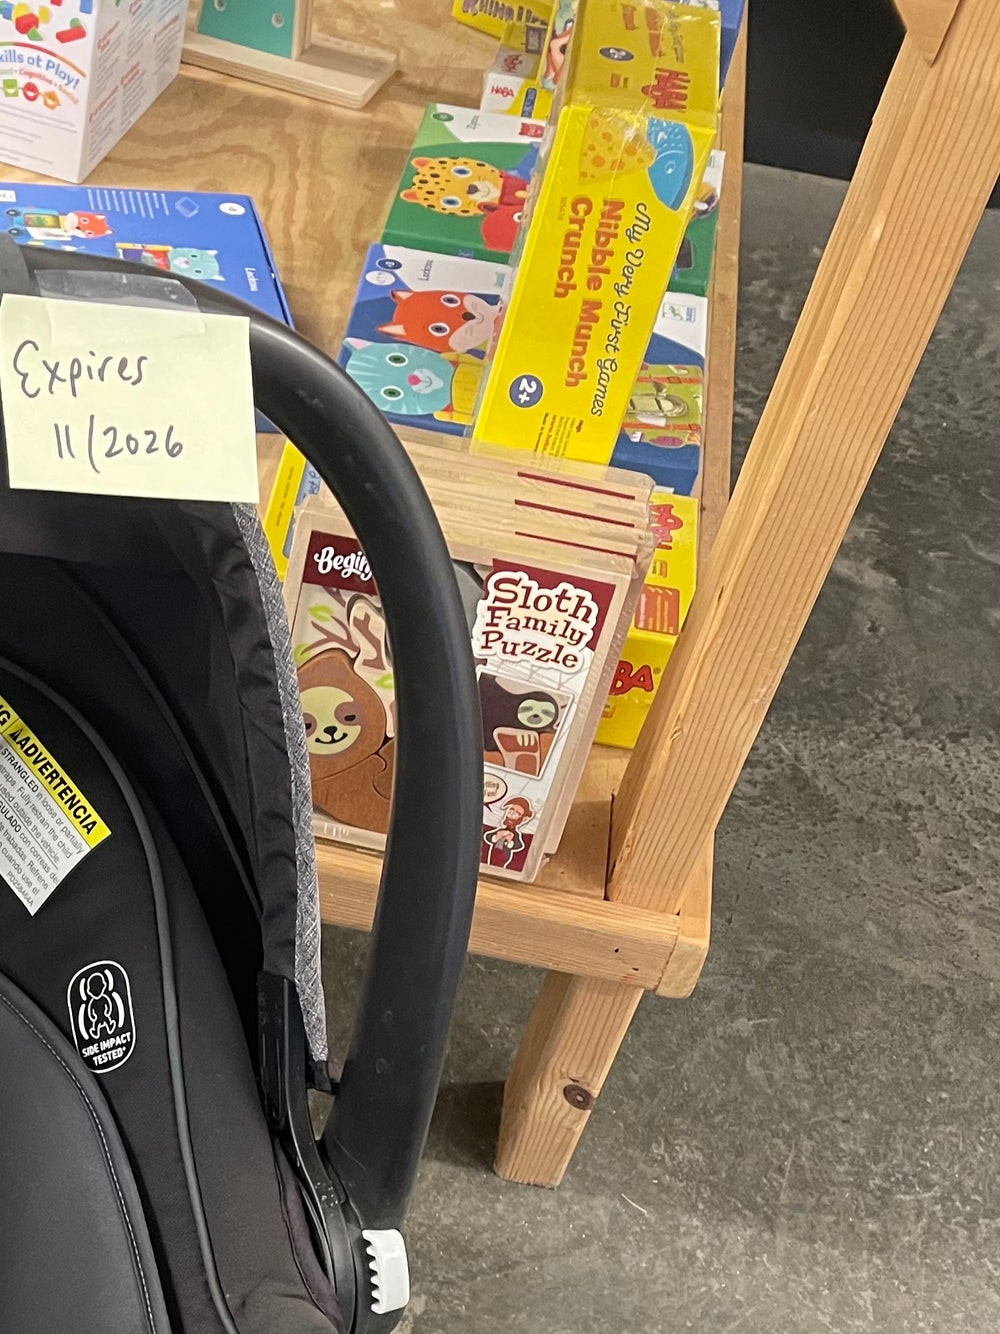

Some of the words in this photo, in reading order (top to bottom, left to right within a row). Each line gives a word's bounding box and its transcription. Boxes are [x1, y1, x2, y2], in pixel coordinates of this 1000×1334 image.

[27, 55, 43, 67] at
[46, 59, 80, 88] Play!
[626, 202, 651, 244] My
[554, 196, 593, 298] Crunch
[586, 198, 625, 291] Nibble
[614, 248, 644, 298] Very
[565, 299, 602, 388] Munch
[605, 300, 633, 353] First
[13, 339, 148, 398] Expires
[591, 356, 619, 417] Games
[518, 378, 537, 403] 2+
[53, 414, 184, 474] 11/2026
[492, 577, 592, 624] Sloth
[486, 605, 587, 646] Family
[481, 630, 579, 669] Puzzle
[609, 660, 654, 696] BA
[1, 748, 40, 793] STRANGLED
[15, 735, 98, 835] ADVERTENCIA
[35, 791, 44, 800] in
[39, 797, 59, 819] loose
[11, 801, 35, 827] outside
[29, 824, 43, 839] the
[14, 786, 34, 806] Fully
[28, 803, 52, 829] restrain
[47, 827, 60, 841] the
[56, 839, 74, 859] child
[55, 817, 64, 827] or
[59, 825, 86, 855] partially
[0, 846, 25, 875] cuando
[20, 873, 34, 888] use
[18, 832, 32, 847] con
[28, 846, 53, 873] correas
[82, 1043, 99, 1057] SIDE
[100, 1032, 131, 1051] IMPACT
